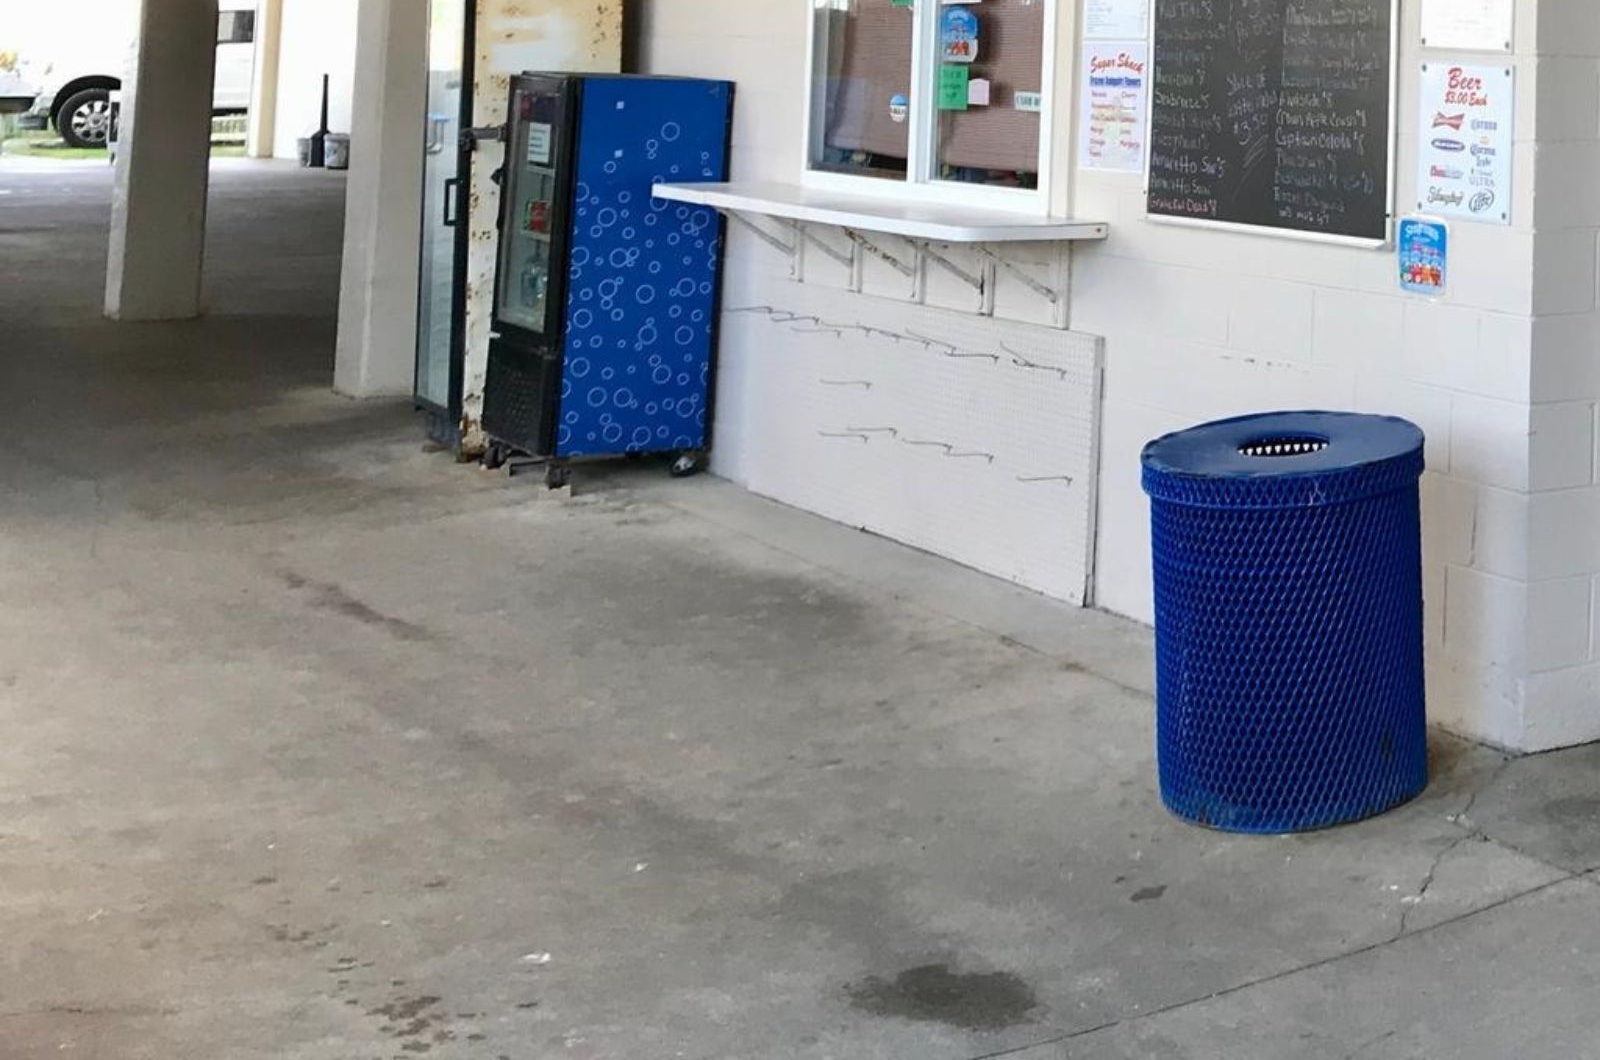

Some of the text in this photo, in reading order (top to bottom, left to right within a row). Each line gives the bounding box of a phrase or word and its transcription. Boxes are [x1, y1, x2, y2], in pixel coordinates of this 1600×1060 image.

[1090, 55, 1115, 73] Sugar
[1117, 52, 1144, 73] Shack
[1448, 67, 1482, 90] Beer
